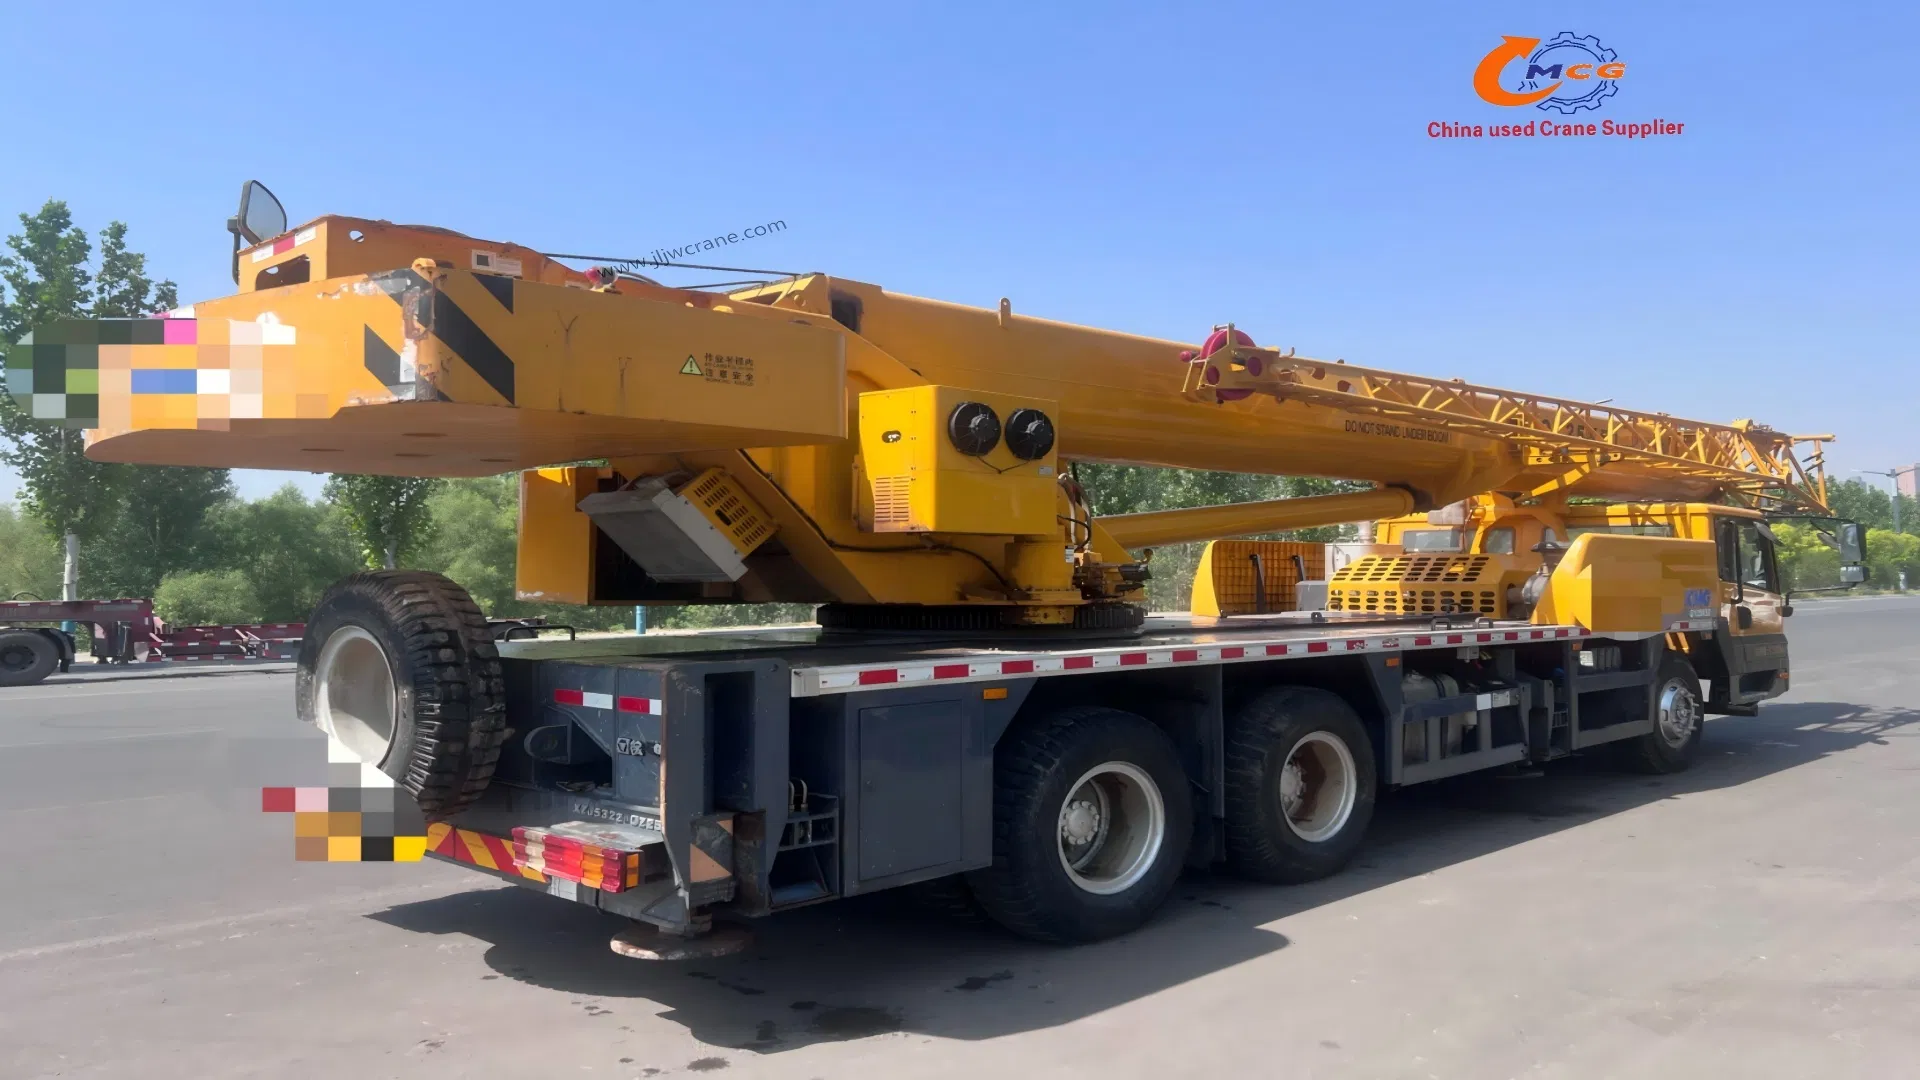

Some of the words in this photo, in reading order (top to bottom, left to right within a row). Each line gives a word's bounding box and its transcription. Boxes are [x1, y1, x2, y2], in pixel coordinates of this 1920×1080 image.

[1345, 420, 1357, 432] DO
[1359, 421, 1375, 434] NOT
[1376, 424, 1400, 437] STAND
[1402, 427, 1427, 440] UNDER
